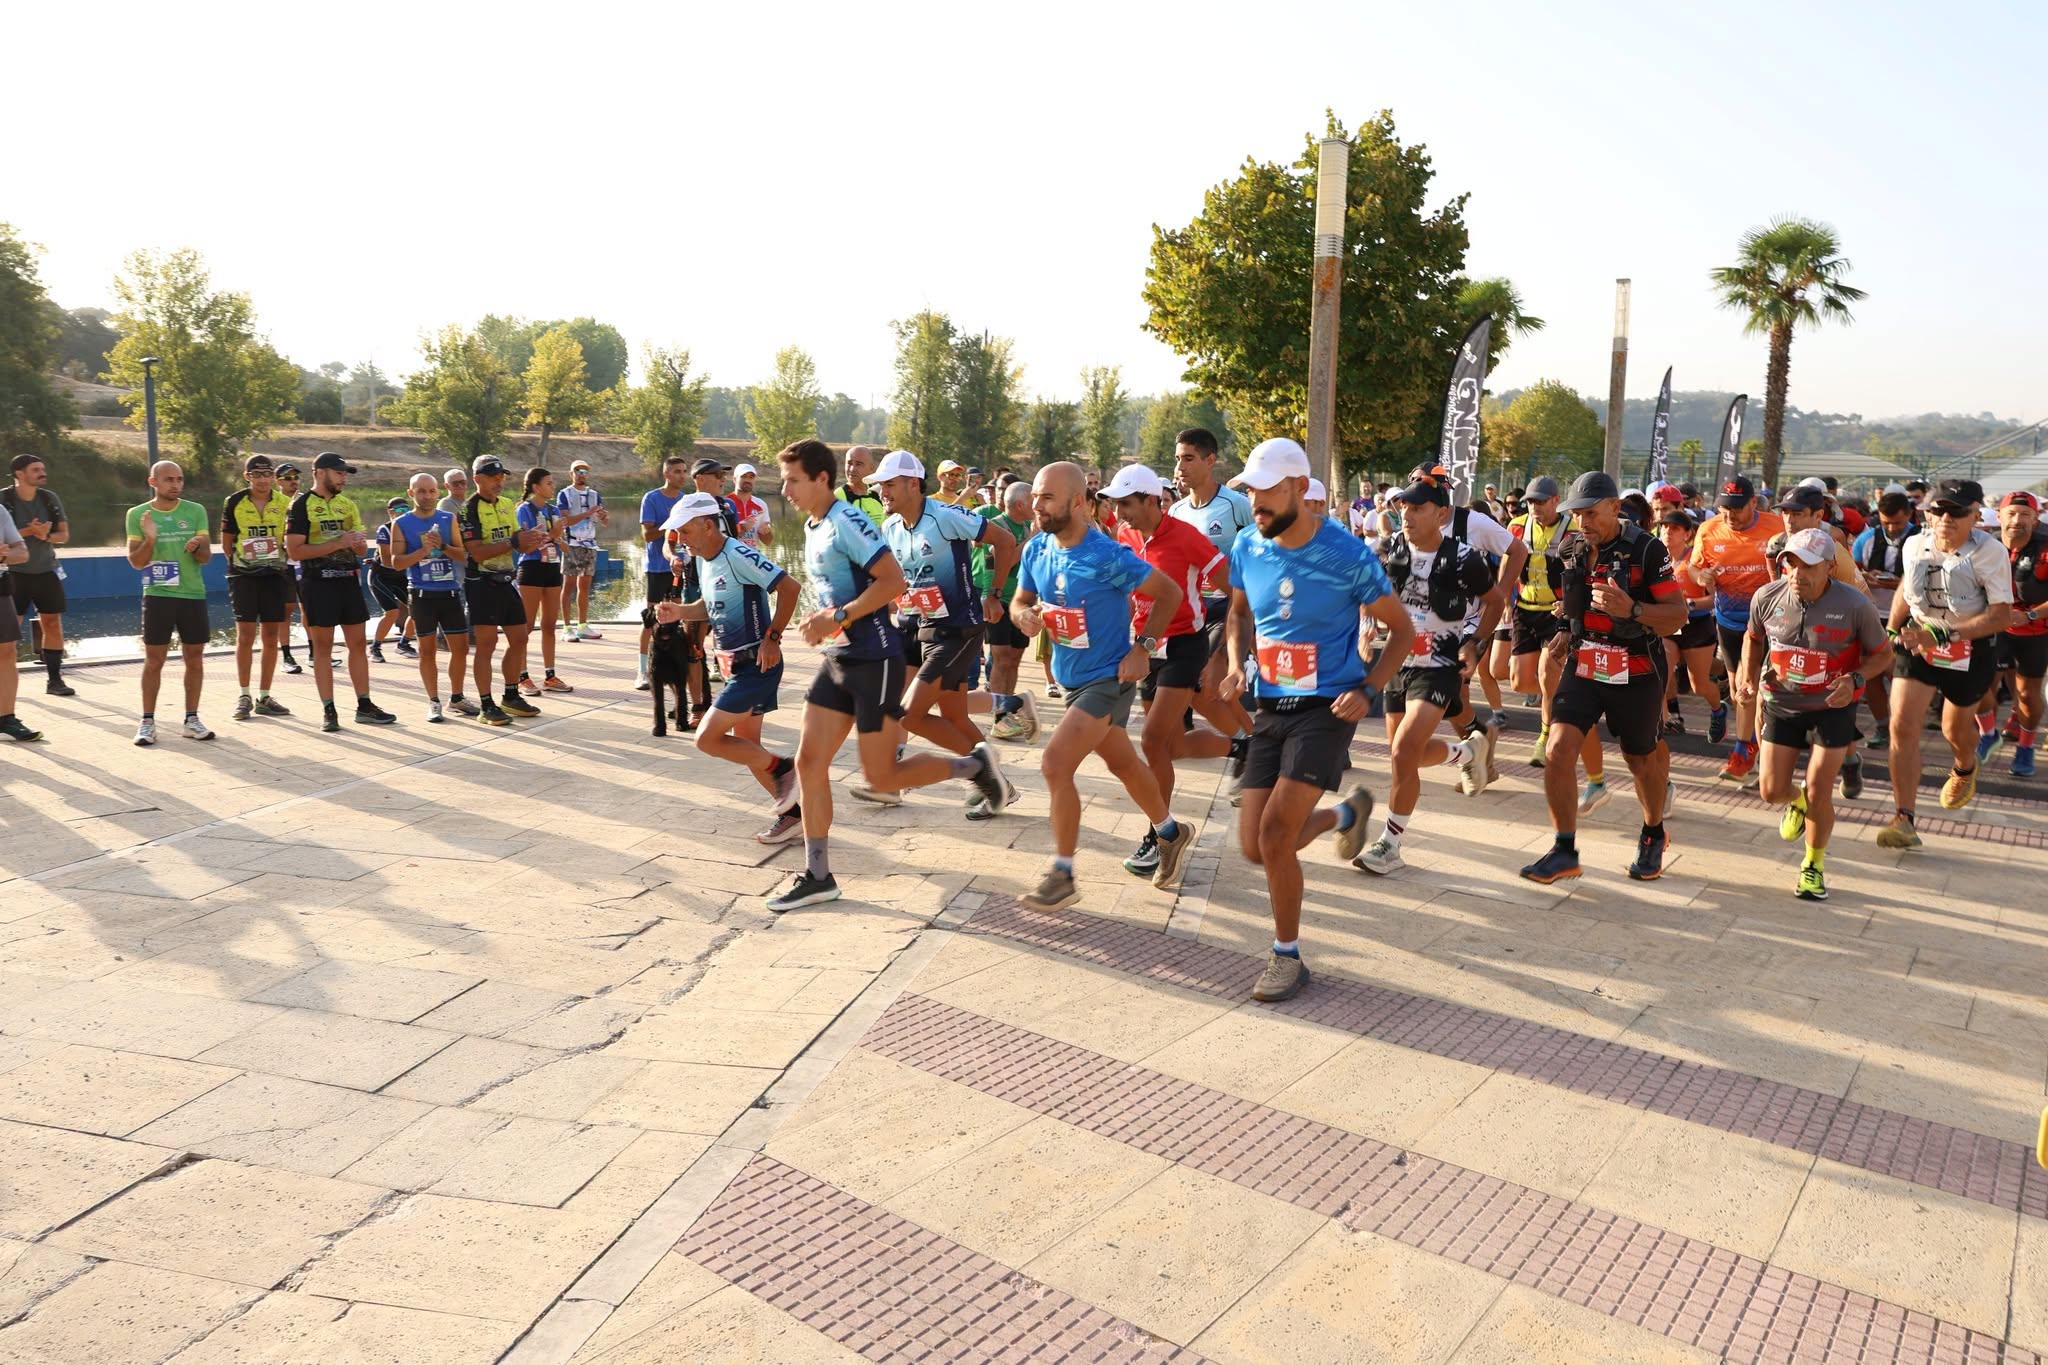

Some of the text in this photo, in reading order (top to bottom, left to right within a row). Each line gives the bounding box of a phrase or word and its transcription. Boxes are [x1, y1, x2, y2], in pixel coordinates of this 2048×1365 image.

[152, 565, 168, 575] 501
[430, 562, 444, 572] 411
[1055, 614, 1068, 630] 51
[1595, 652, 1608, 667] 54
[1790, 654, 1805, 668] 45
